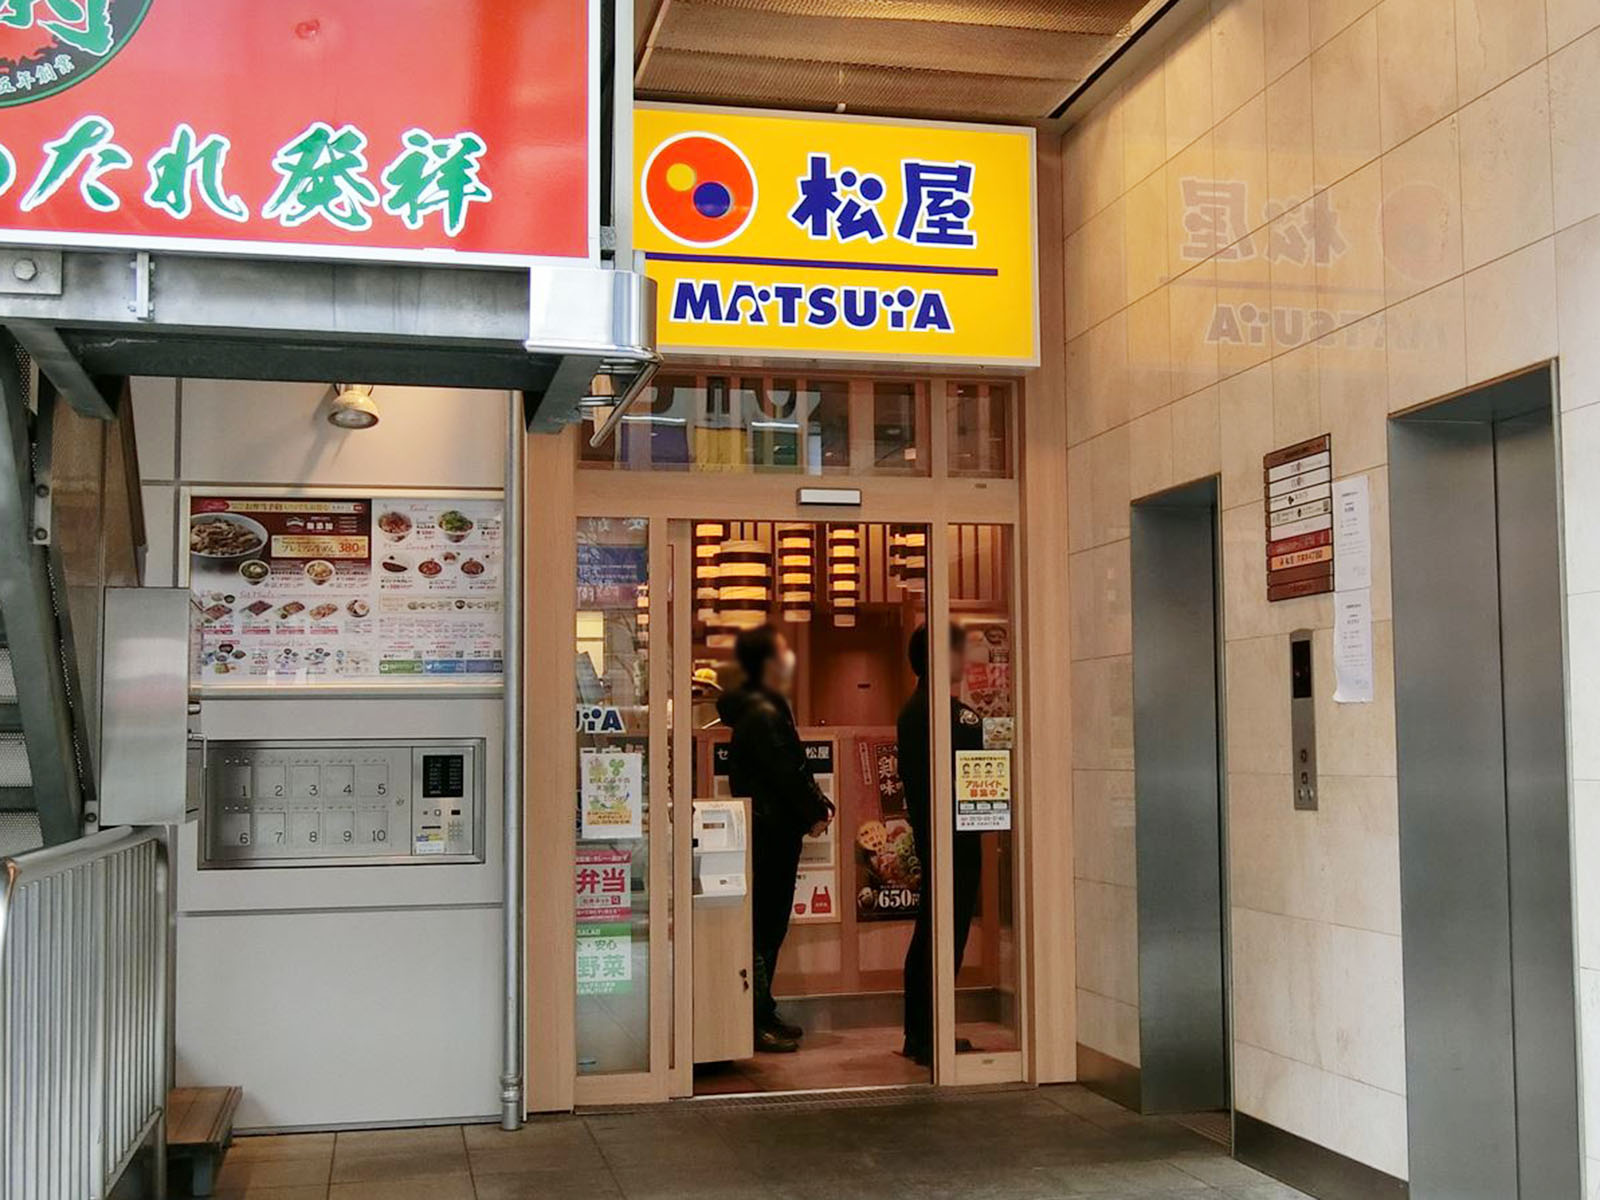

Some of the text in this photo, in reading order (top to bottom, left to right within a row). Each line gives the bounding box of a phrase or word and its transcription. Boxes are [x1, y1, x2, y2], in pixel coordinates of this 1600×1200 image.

[0, 114, 493, 238] たれ発祥
[787, 152, 977, 249] 松屋
[669, 279, 955, 334] MATSUYA
[241, 785, 248, 797] 1
[274, 785, 284, 797] 2
[308, 785, 318, 796] 3
[343, 784, 353, 796] 4
[377, 784, 386, 795] 5
[239, 833, 249, 844] 6
[275, 832, 284, 844] 7
[308, 831, 318, 842] 8
[343, 831, 352, 842] 9
[372, 830, 386, 842] 10
[578, 954, 625, 978] 野菜
